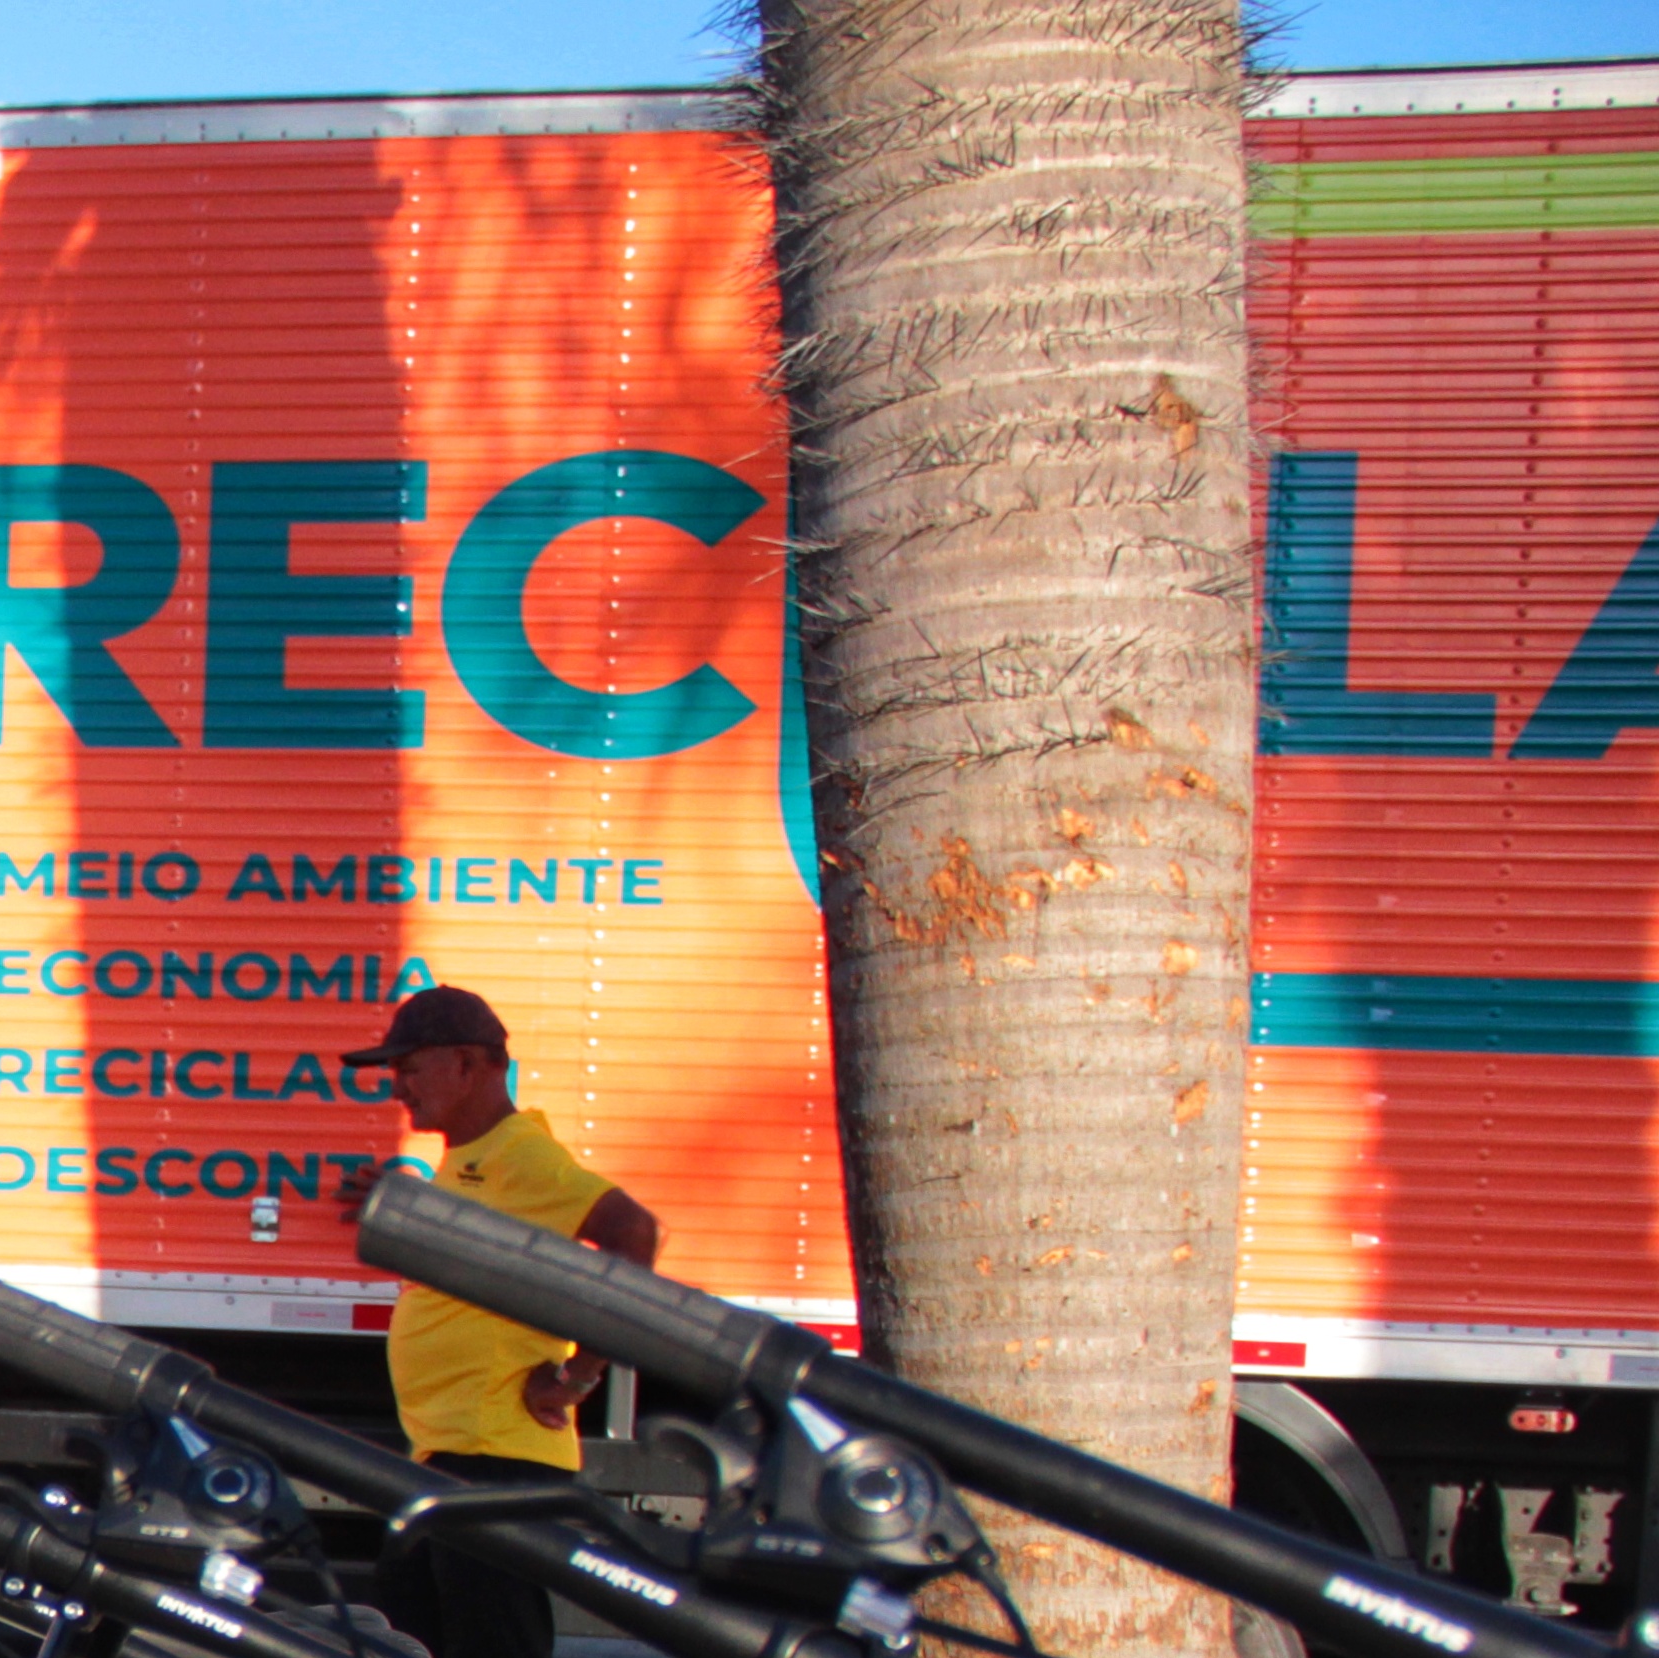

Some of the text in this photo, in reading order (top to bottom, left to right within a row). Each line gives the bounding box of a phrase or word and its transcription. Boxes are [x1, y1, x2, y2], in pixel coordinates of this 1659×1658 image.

[225, 851, 665, 907] AMBIENTE
[754, 1534, 824, 1558] GTS
[570, 1549, 679, 1607] INVIKTUS
[156, 1592, 246, 1639] INVIKTUS
[1322, 1575, 1474, 1653] INVIKTUS
